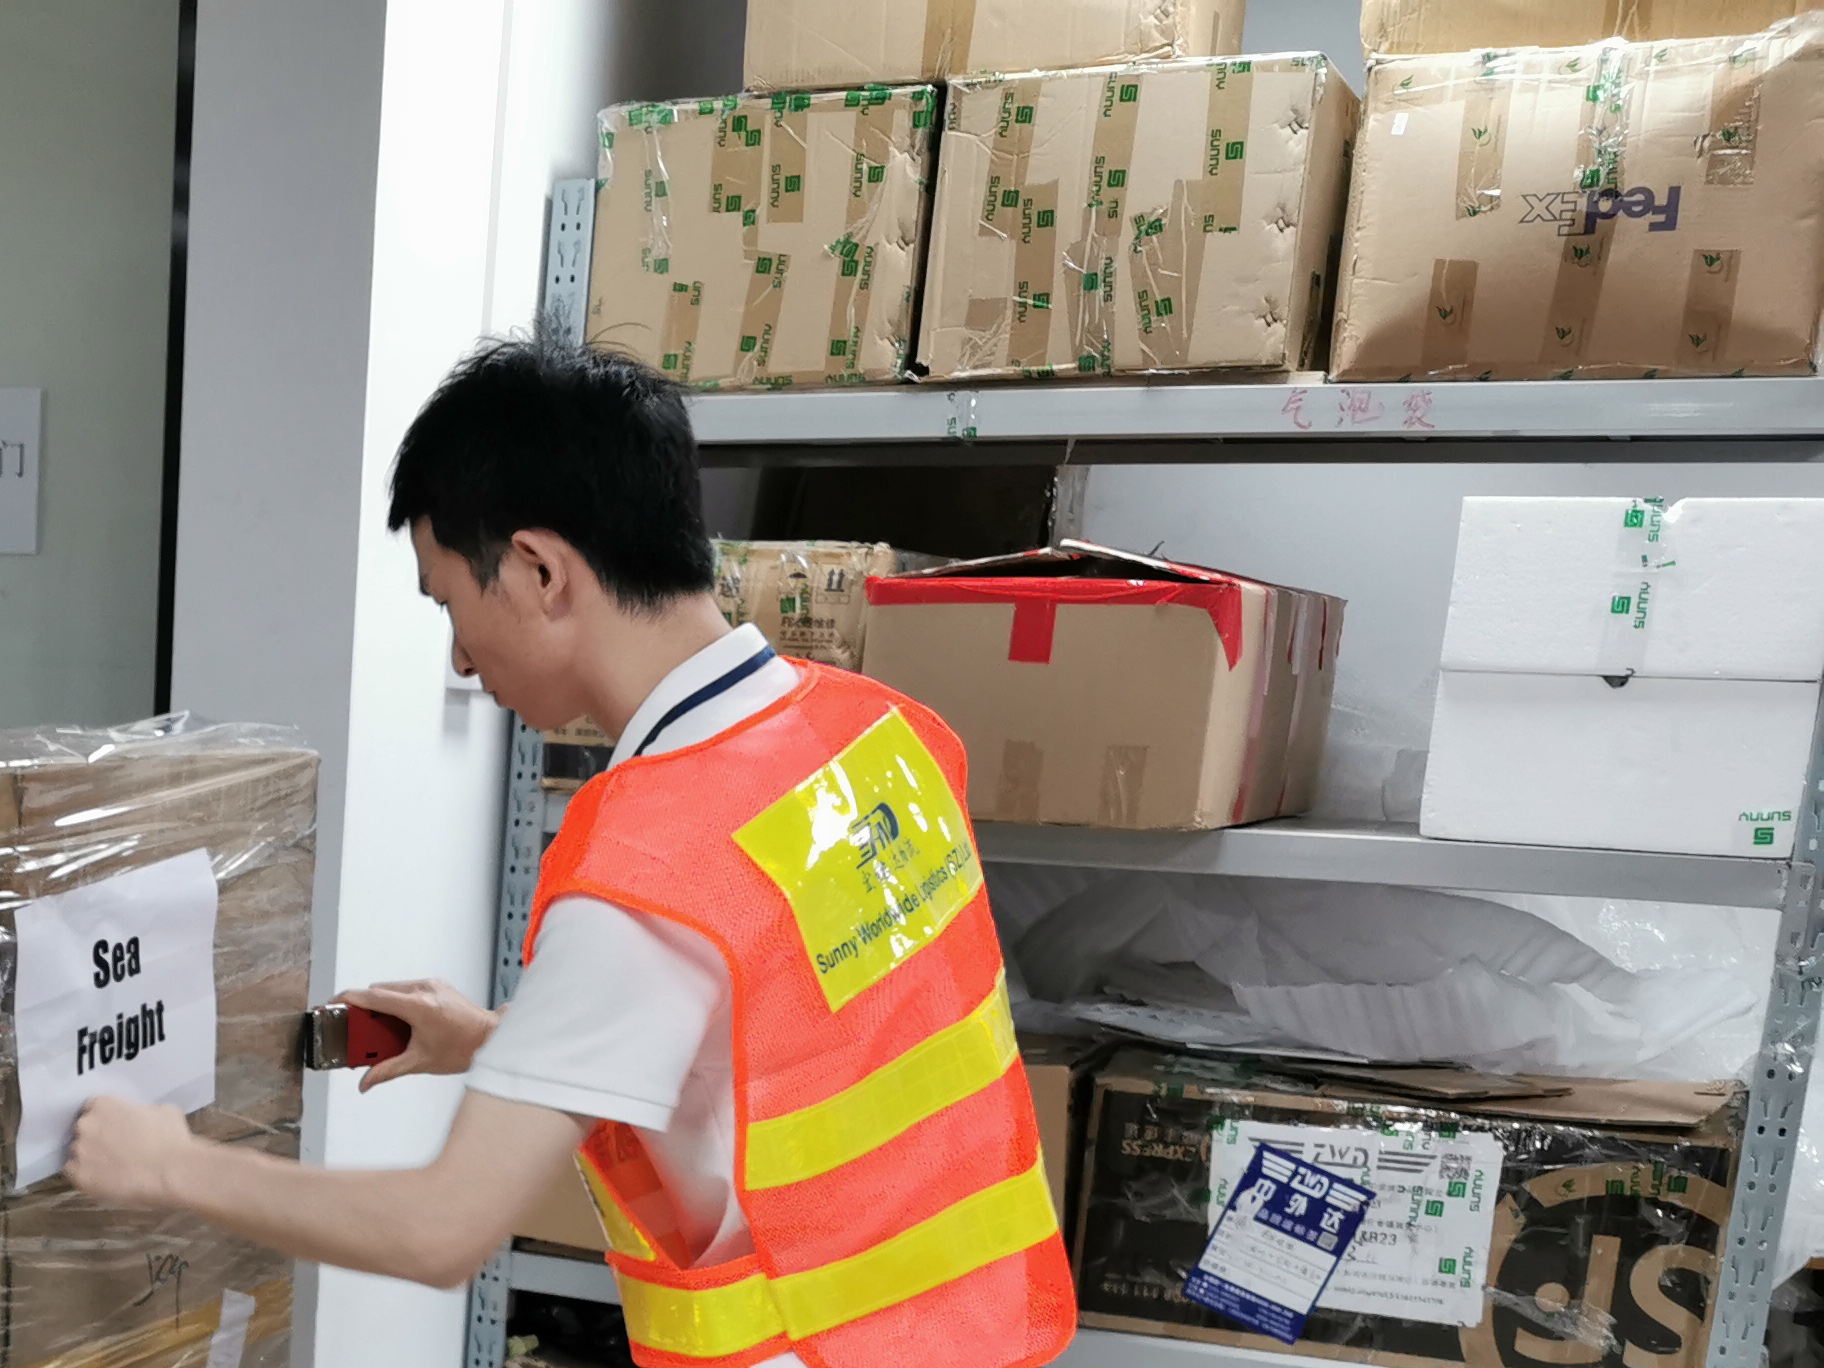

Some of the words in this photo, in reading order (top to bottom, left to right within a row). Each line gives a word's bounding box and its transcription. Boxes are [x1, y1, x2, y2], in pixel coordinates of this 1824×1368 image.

[93, 936, 142, 989] Sea
[816, 936, 859, 975] Sunny
[77, 1000, 166, 1075] Freight
